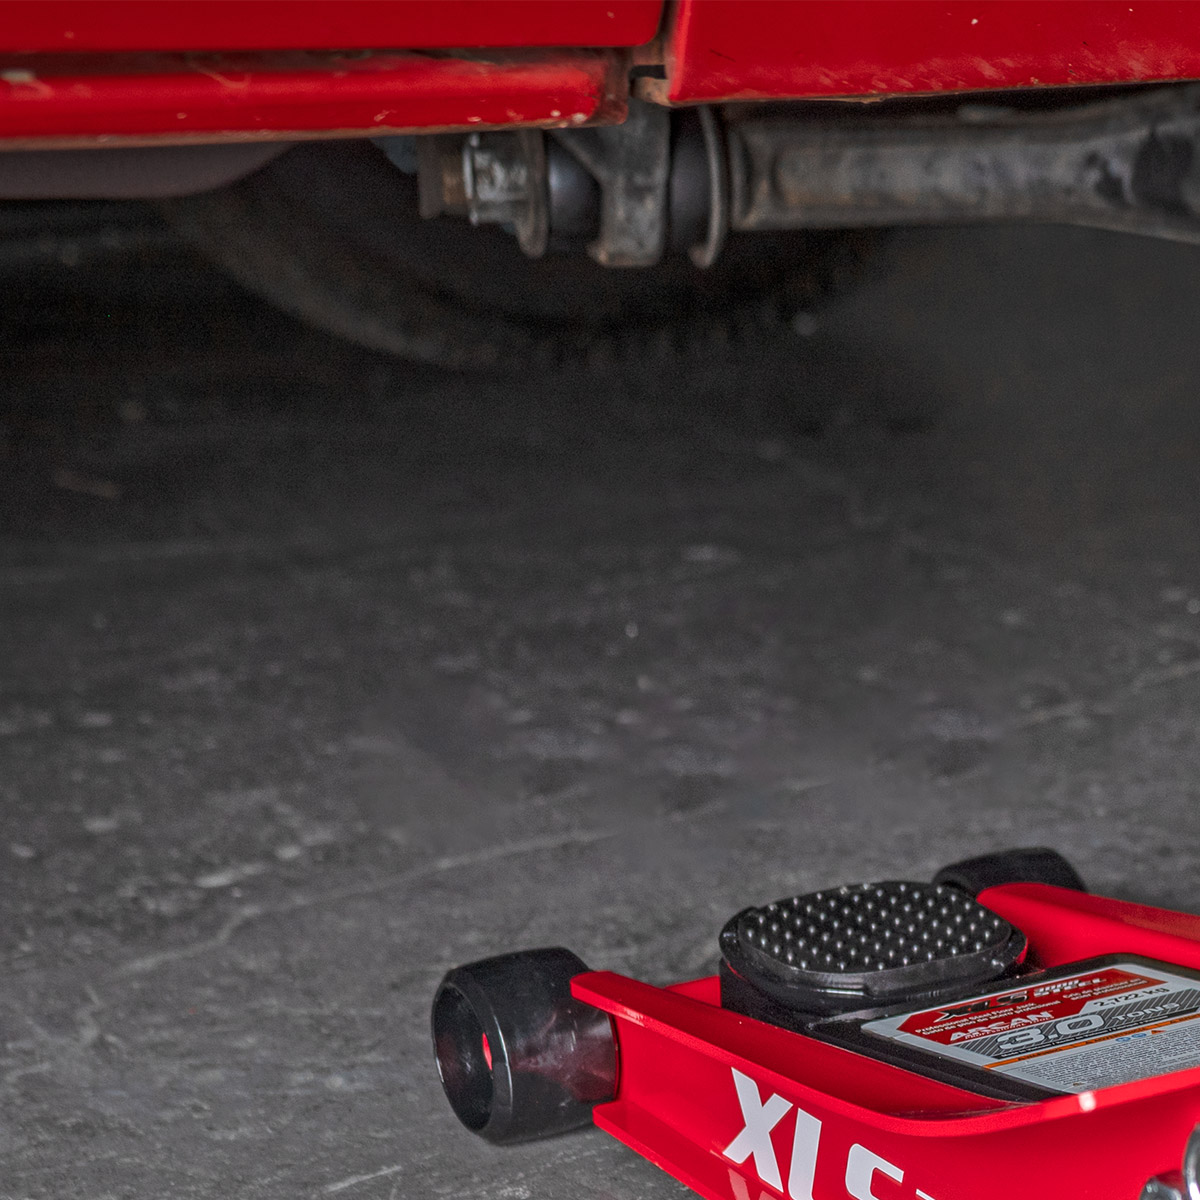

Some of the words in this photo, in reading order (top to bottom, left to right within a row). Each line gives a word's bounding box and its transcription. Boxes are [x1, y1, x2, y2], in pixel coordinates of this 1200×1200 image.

[950, 1011, 1054, 1041] ARCAN
[997, 1014, 1105, 1050] 3.0
[1111, 1002, 1180, 1021] TONS
